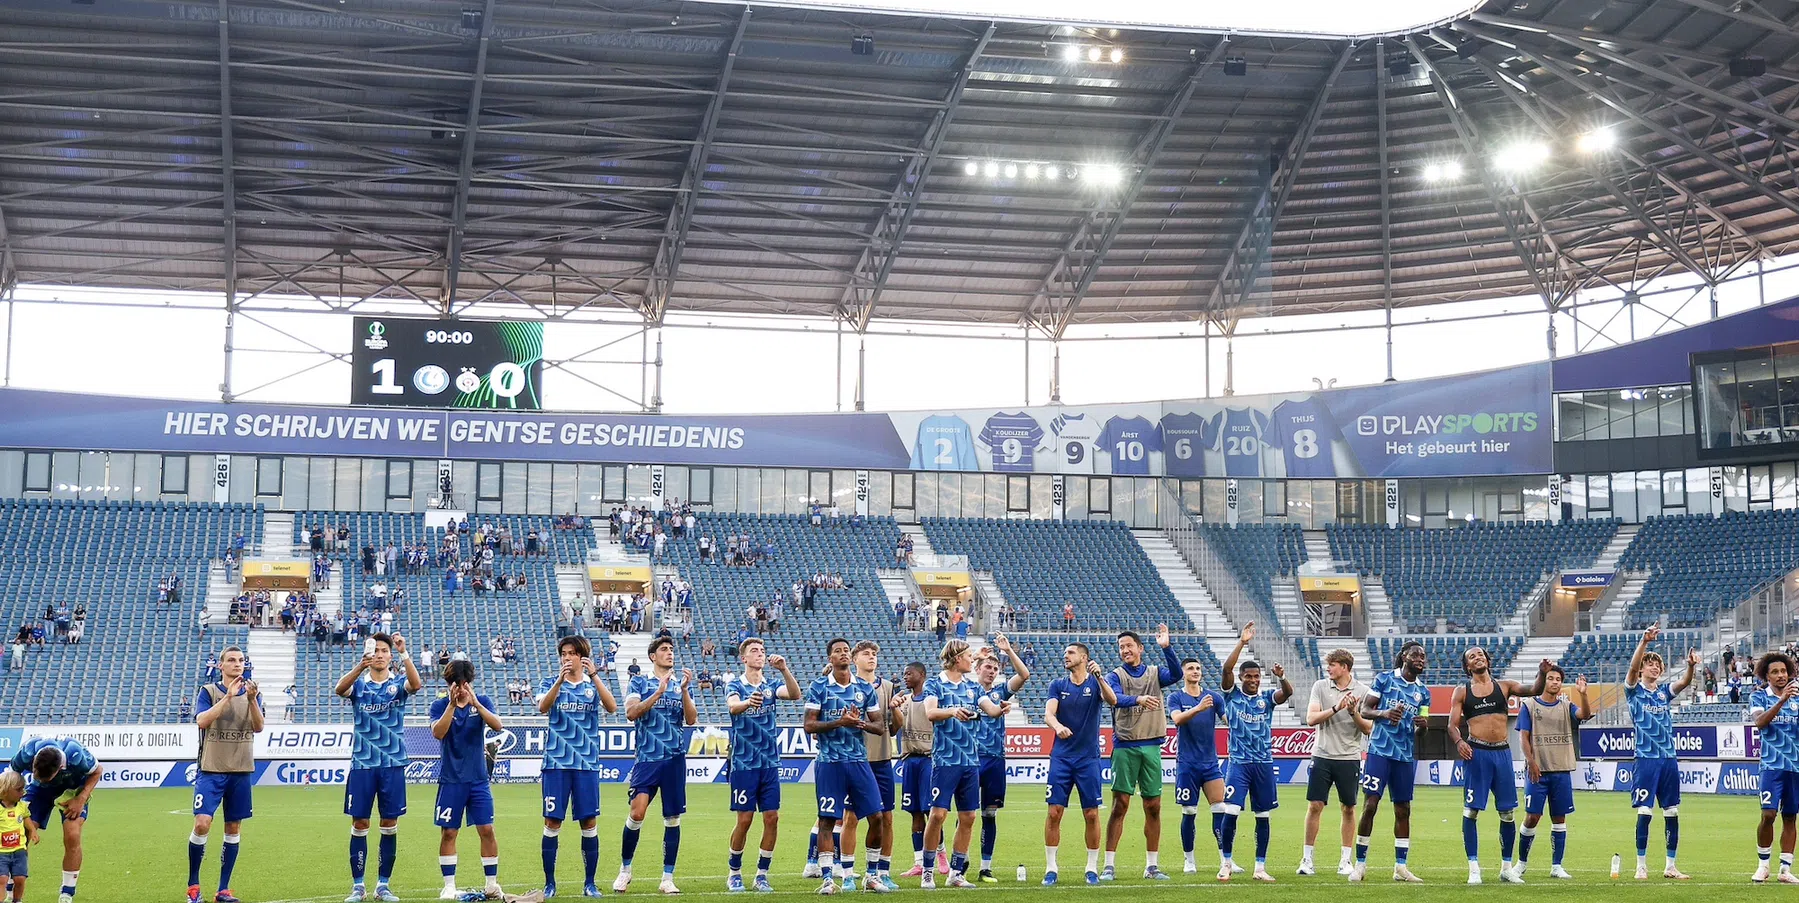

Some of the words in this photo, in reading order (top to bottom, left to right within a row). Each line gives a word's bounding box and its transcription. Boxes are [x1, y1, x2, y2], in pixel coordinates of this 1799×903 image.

[426, 330, 473, 344] 90:00
[371, 359, 404, 394] 1
[490, 362, 526, 397] 0
[164, 412, 229, 435] HIER
[234, 413, 390, 440] SCHRIJVEN
[398, 419, 440, 441] WE
[450, 419, 555, 444] GENTSE
[560, 422, 745, 449] GESCHIEDENIS
[934, 438, 953, 464] 2
[1002, 438, 1023, 464] 9
[1066, 441, 1084, 464] 9
[1116, 441, 1144, 461] 10
[1175, 438, 1192, 460] 6
[1226, 436, 1258, 456] 20
[1293, 429, 1319, 459] 8
[1386, 441, 1413, 455] Het
[1418, 441, 1477, 457] gebeurt
[1481, 439, 1511, 453] hier
[217, 463, 228, 487] 426
[653, 474, 662, 497] 424
[857, 478, 866, 501] 424
[1053, 483, 1062, 506] 423
[1550, 483, 1559, 506] 422
[1712, 476, 1721, 498] 421
[1228, 487, 1237, 509] 422
[1387, 487, 1397, 509] 422
[104, 733, 115, 747] IN
[119, 733, 134, 747] ICT
[137, 733, 144, 747] &
[148, 733, 183, 747] DIGITAL
[219, 731, 251, 740] RESPEC
[267, 732, 354, 747] Haman
[1609, 732, 1635, 751] baloi
[121, 770, 160, 783] Group
[277, 763, 345, 783] Circus
[1006, 766, 1034, 777] AFT
[1363, 774, 1380, 792] 23
[194, 794, 204, 809] 8
[733, 789, 748, 805] 16
[1176, 787, 1190, 801] 28
[1634, 788, 1649, 802] 19
[435, 806, 452, 823] 14
[820, 796, 836, 813] 22
